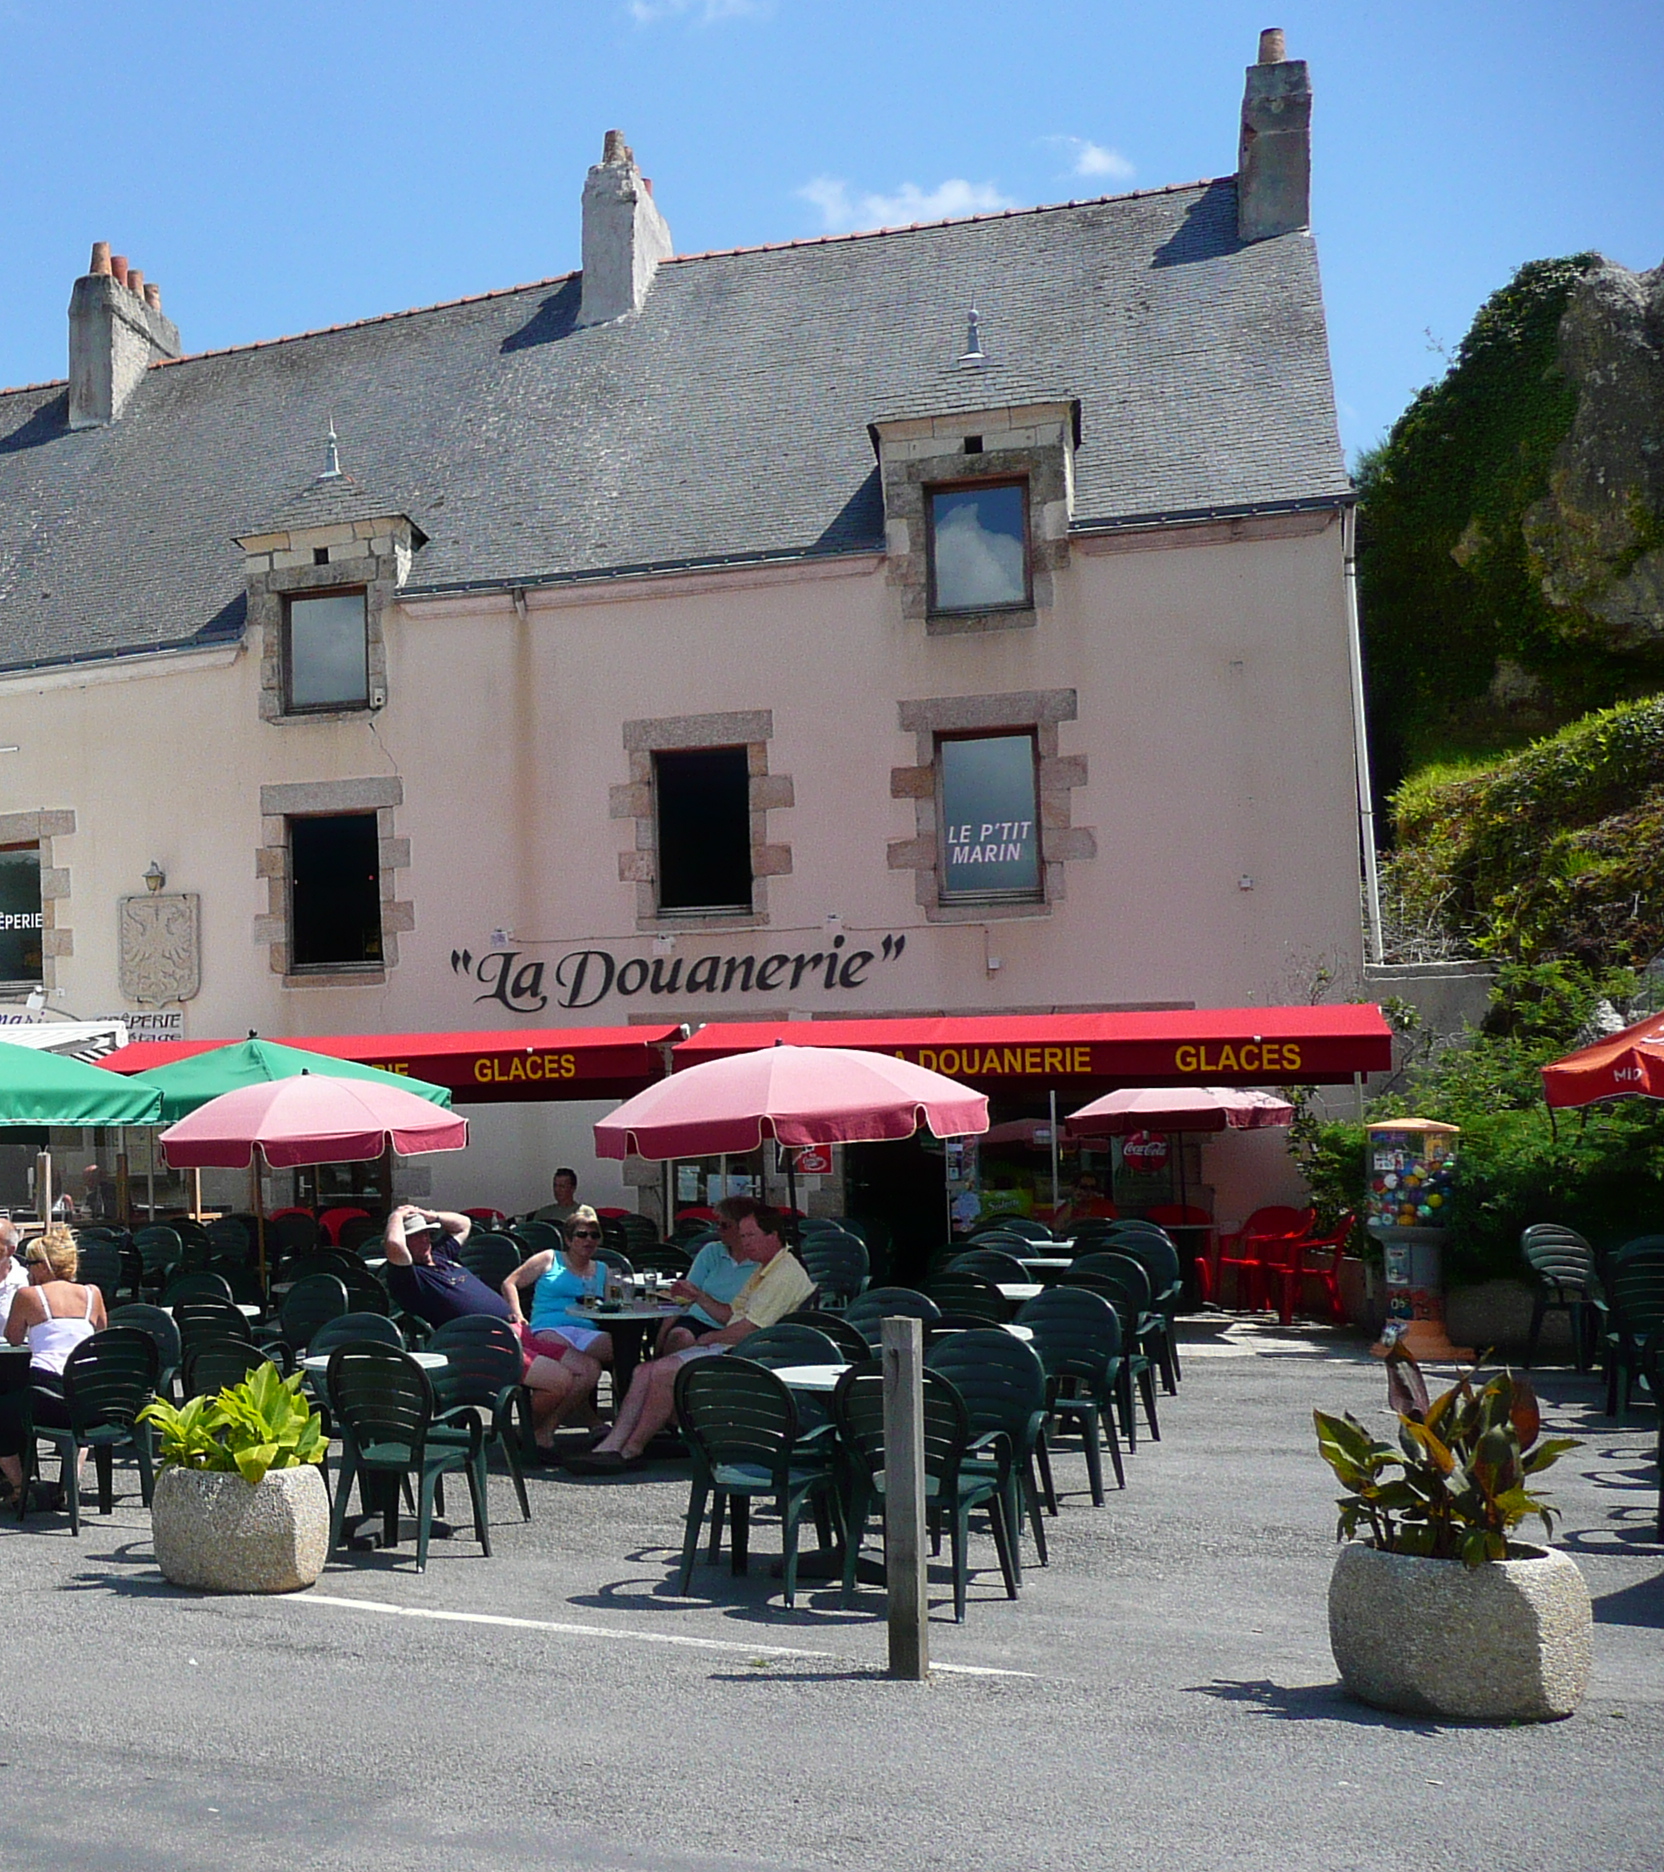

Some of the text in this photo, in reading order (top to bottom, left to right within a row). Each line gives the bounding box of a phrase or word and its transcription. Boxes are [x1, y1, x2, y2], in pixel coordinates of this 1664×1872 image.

[948, 821, 1032, 844] LE P'TIT
[952, 843, 1021, 864] MARIN
[473, 1053, 577, 1083] GLACES
[919, 1046, 1092, 1074] DOUANERIE
[1174, 1043, 1303, 1072] GLACES
